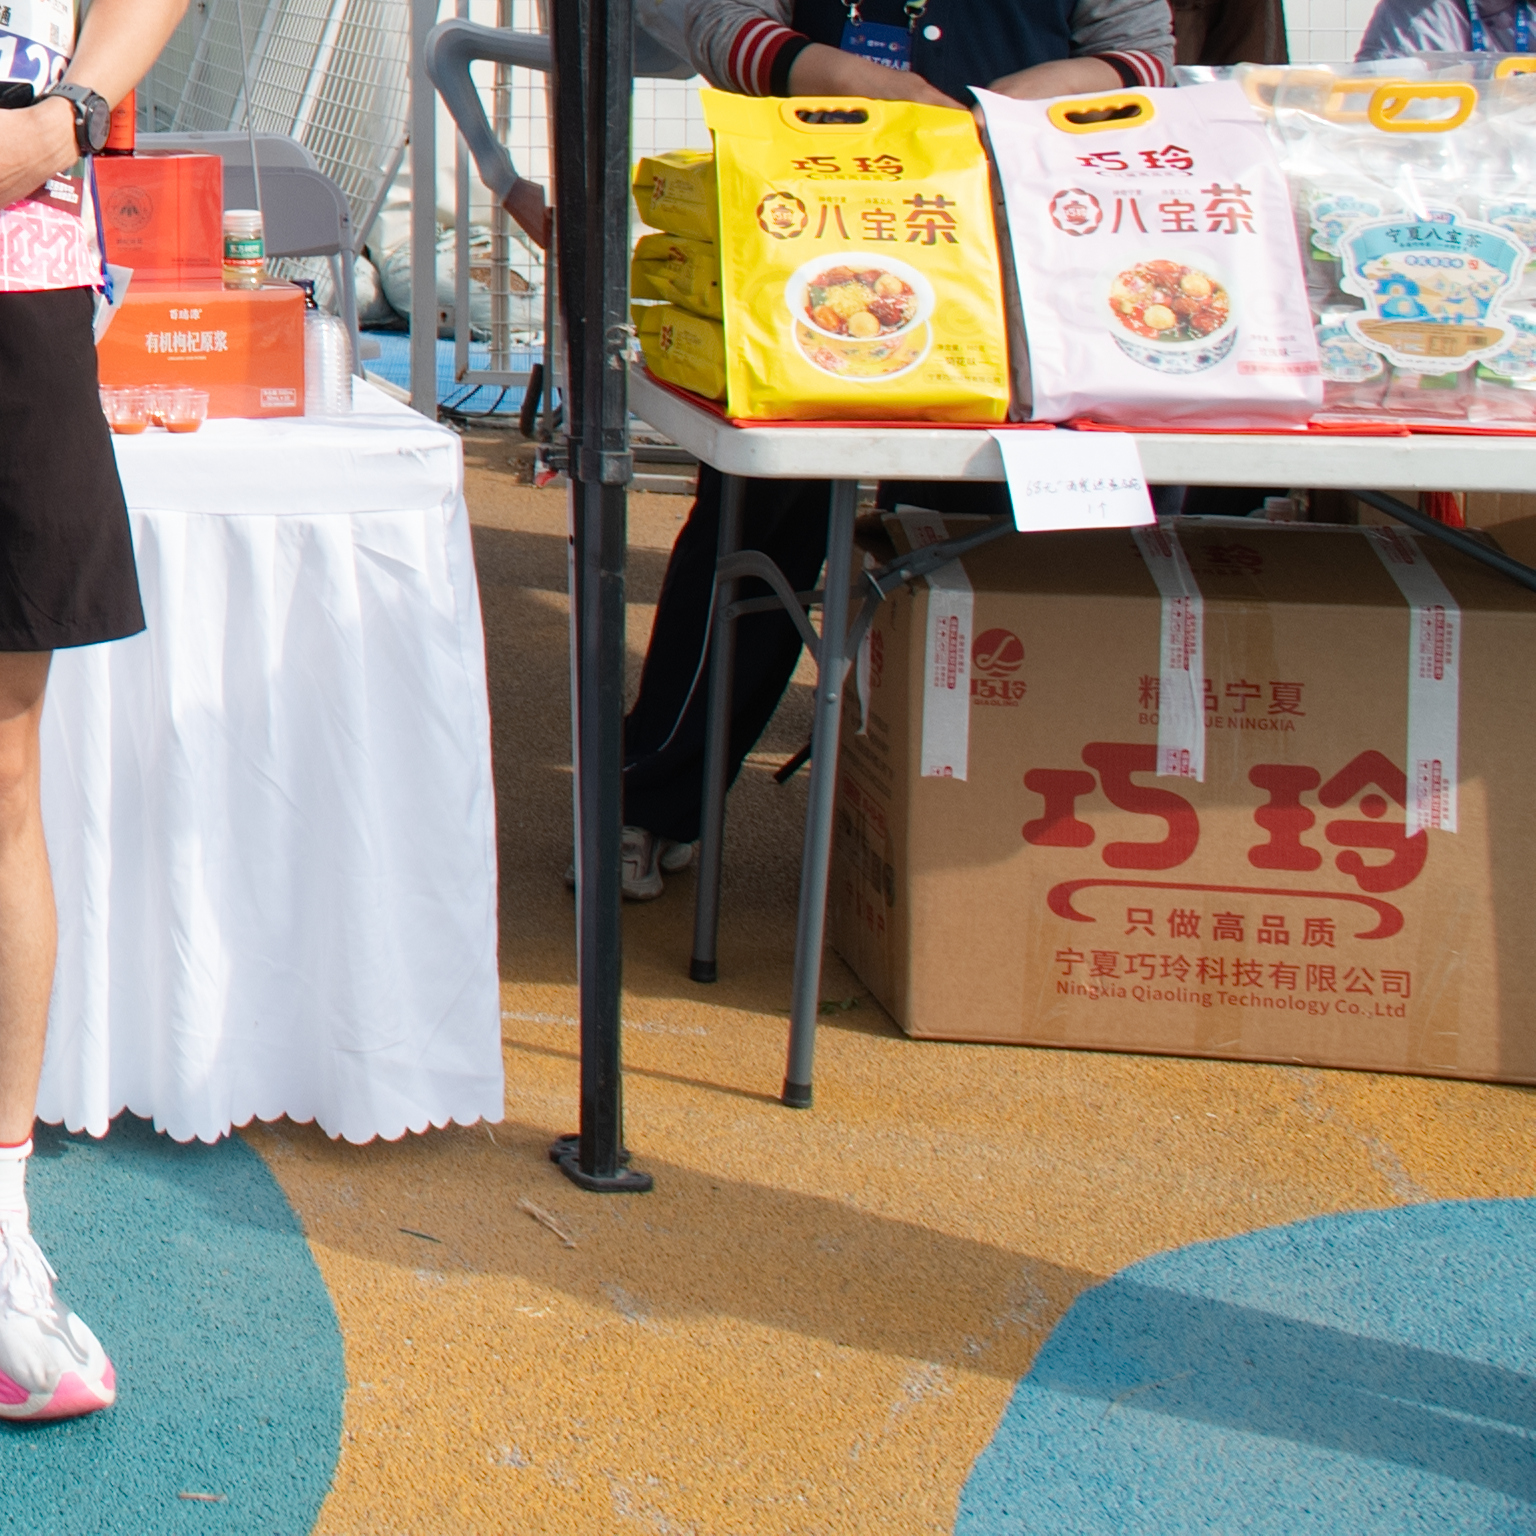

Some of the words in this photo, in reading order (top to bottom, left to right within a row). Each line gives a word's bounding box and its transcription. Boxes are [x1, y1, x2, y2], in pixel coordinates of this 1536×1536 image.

[814, 192, 960, 246] 八宝茶
[1110, 182, 1258, 235] 八宝茶
[1385, 225, 1482, 248] 宁夏八宝茶
[144, 330, 229, 354] 有机枸杞原浆
[1226, 716, 1296, 732] NINGXIA
[1022, 740, 1429, 895] 巧玲
[1124, 906, 1337, 949] 只做高品质
[1054, 946, 1412, 1000] 宁夏巧玲科技有限公司
[1056, 979, 1128, 1001] Ningxia
[1131, 984, 1214, 1009] Qiaoling
[1216, 990, 1330, 1016] Technology
